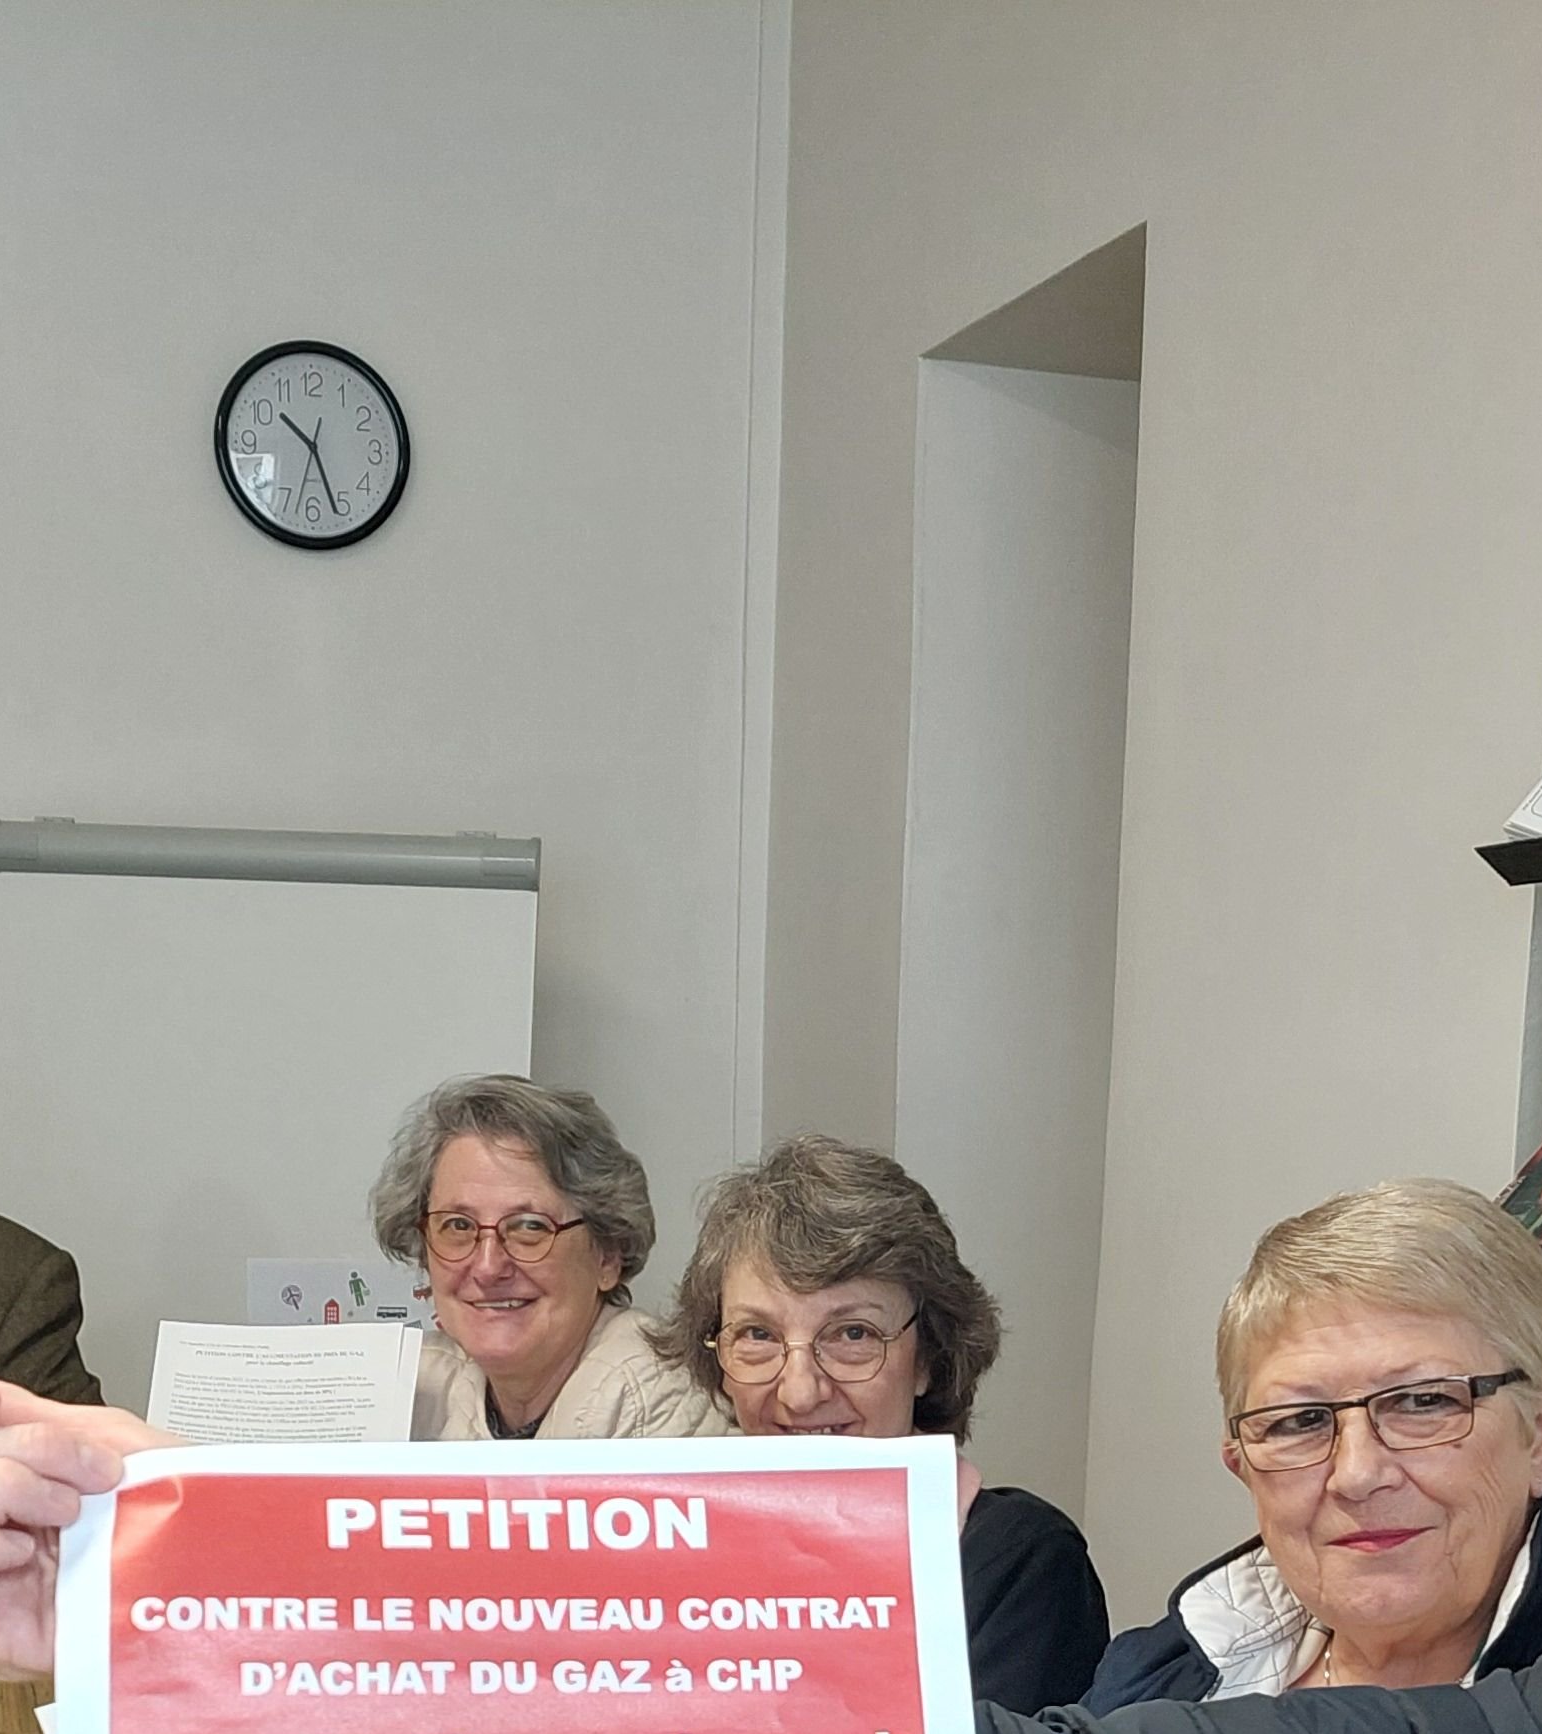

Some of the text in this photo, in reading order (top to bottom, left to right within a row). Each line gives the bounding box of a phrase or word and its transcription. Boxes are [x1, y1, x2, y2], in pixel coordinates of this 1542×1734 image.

[275, 377, 291, 403] 11
[300, 371, 323, 397] 12
[337, 383, 345, 408] 1
[250, 398, 273, 426] 10
[356, 405, 372, 432] 2
[241, 429, 257, 455] 9
[367, 439, 383, 465] 3
[355, 472, 371, 496] 4
[278, 487, 292, 513] 7
[305, 496, 321, 522] 6
[336, 491, 351, 516] 5
[326, 1497, 708, 1550] PETITION
[130, 1596, 897, 1633] CONTRE LE NOUVEAU CONTRAT
[470, 1661, 537, 1695] DU
[552, 1660, 653, 1695] GAZ
[664, 1659, 694, 1694] à
[707, 1659, 803, 1693] CHP
